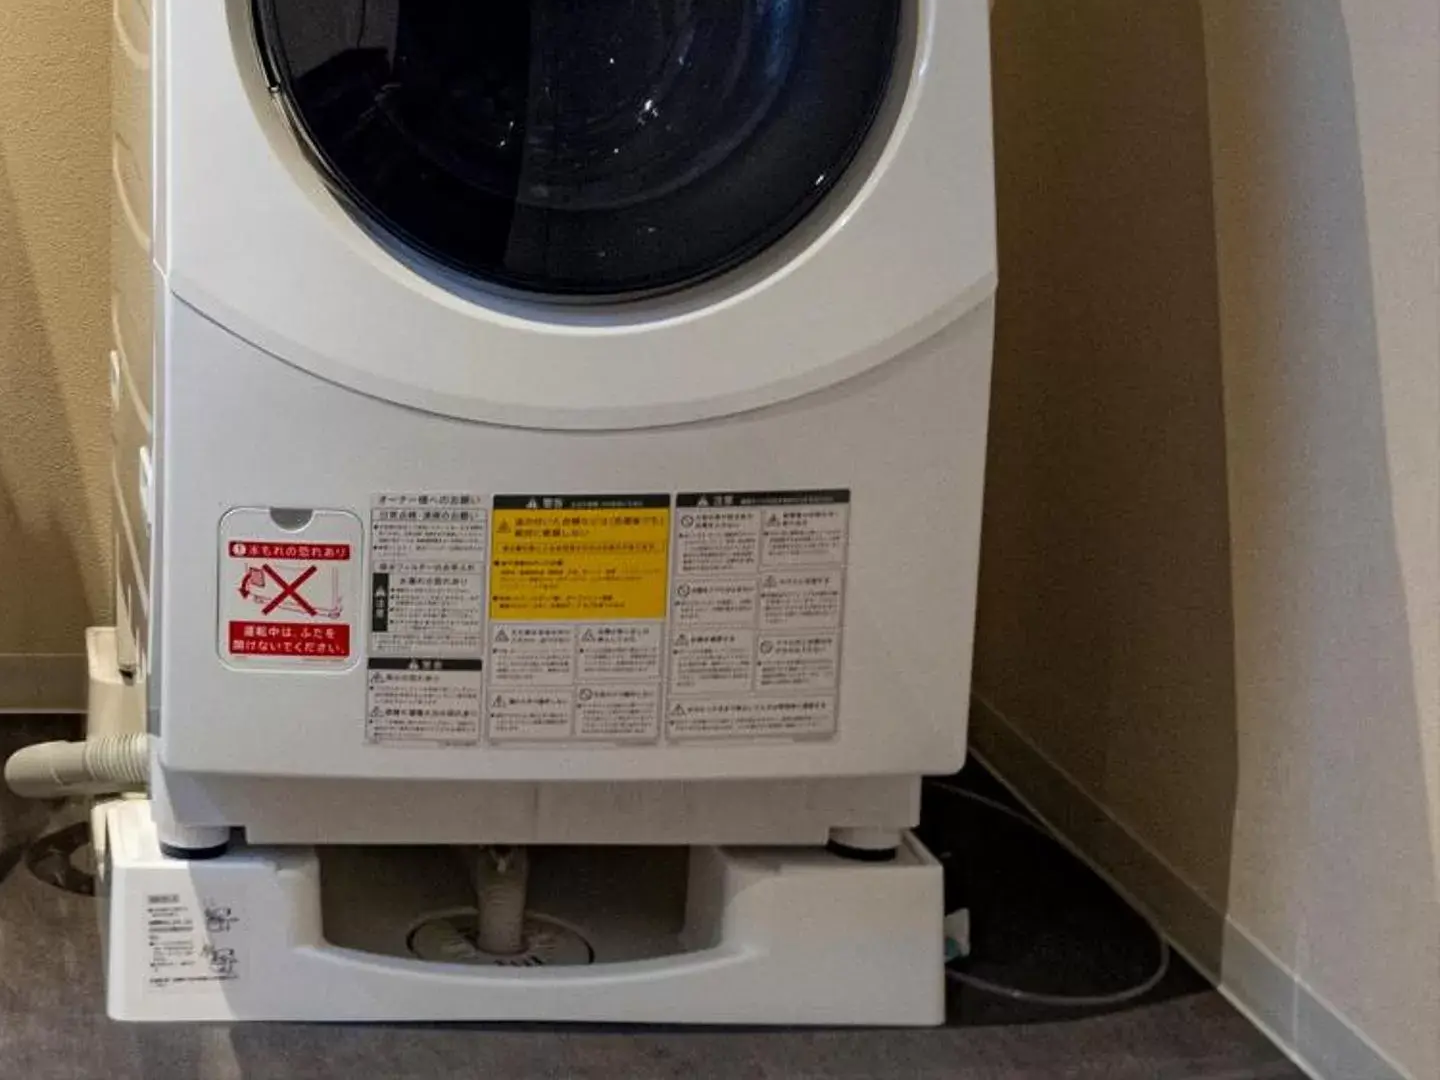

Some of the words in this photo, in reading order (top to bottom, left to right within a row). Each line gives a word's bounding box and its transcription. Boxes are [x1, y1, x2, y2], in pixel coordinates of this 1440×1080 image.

[249, 545, 347, 557] 水もれの恐れあり
[243, 625, 336, 638] 運転中は、ふたを
[232, 639, 346, 653] 開けないでください。
